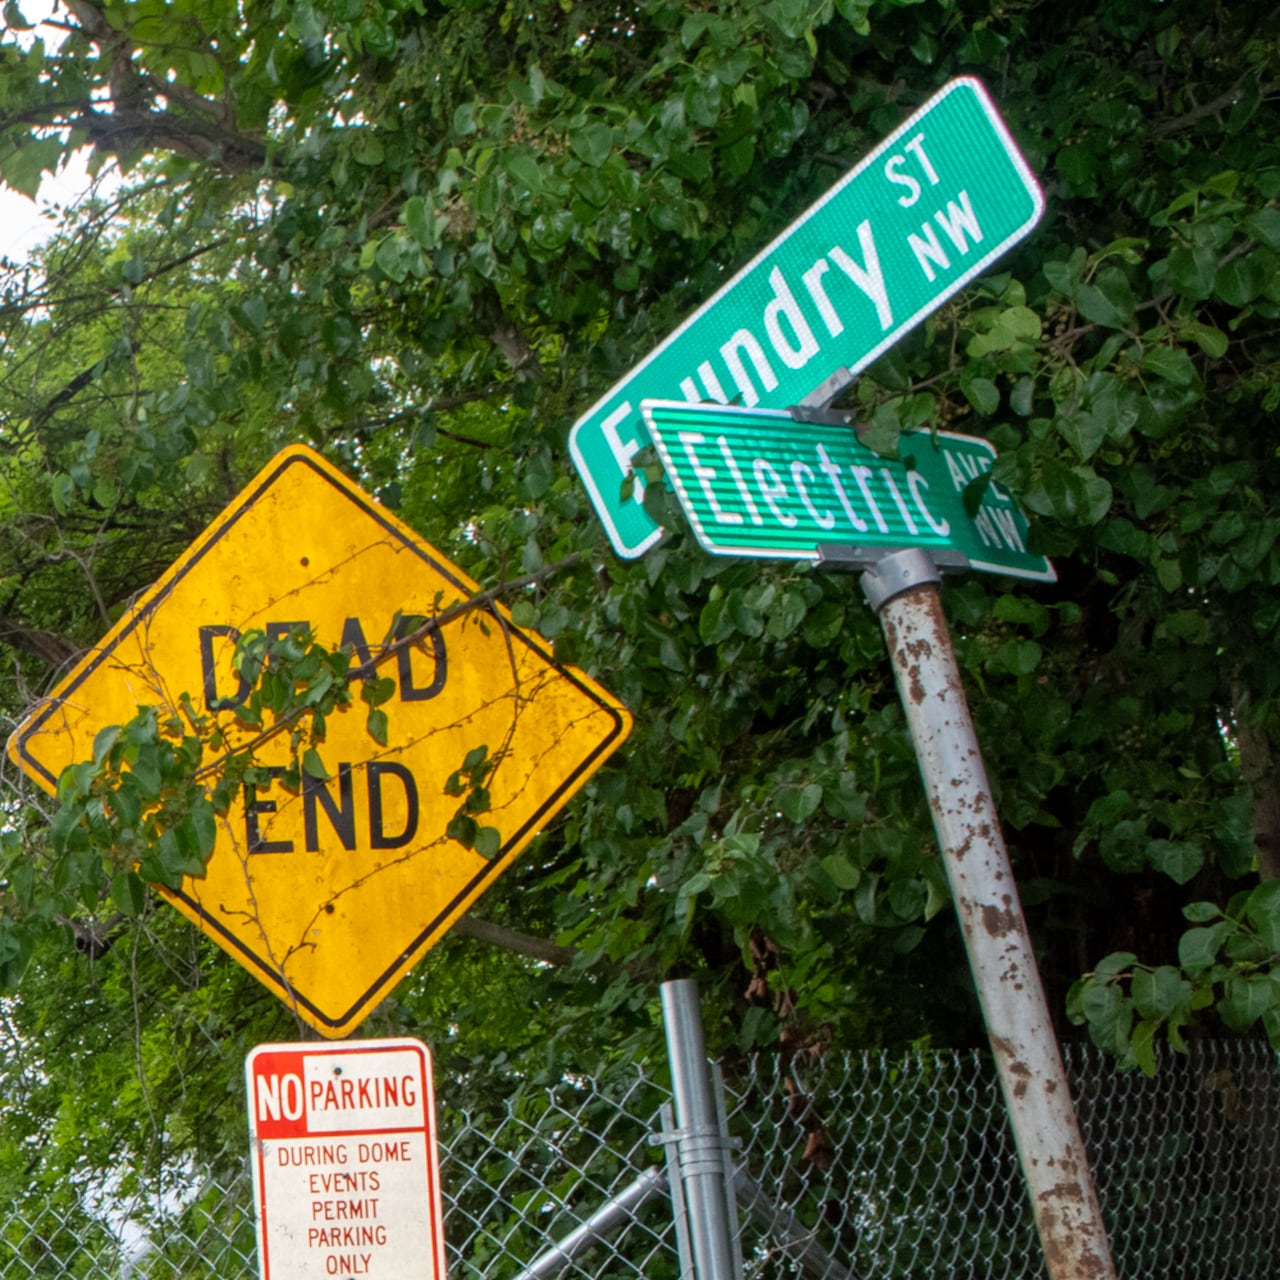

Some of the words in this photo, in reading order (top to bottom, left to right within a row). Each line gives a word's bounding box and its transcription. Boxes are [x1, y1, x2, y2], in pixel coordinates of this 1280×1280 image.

[884, 132, 940, 208] ST
[906, 190, 985, 283] NW
[677, 431, 951, 537] Electric
[973, 503, 1026, 554] NW
[198, 614, 448, 712] DAD
[243, 761, 419, 855] END
[256, 1073, 304, 1122] NO
[309, 1075, 416, 1112] PARKING
[278, 1143, 348, 1167] DURING
[358, 1141, 412, 1163] DOME
[309, 1171, 381, 1194] EVENTS
[312, 1198, 380, 1221] PERMIT
[308, 1225, 387, 1248] PARKING
[325, 1253, 372, 1275] ONLY
